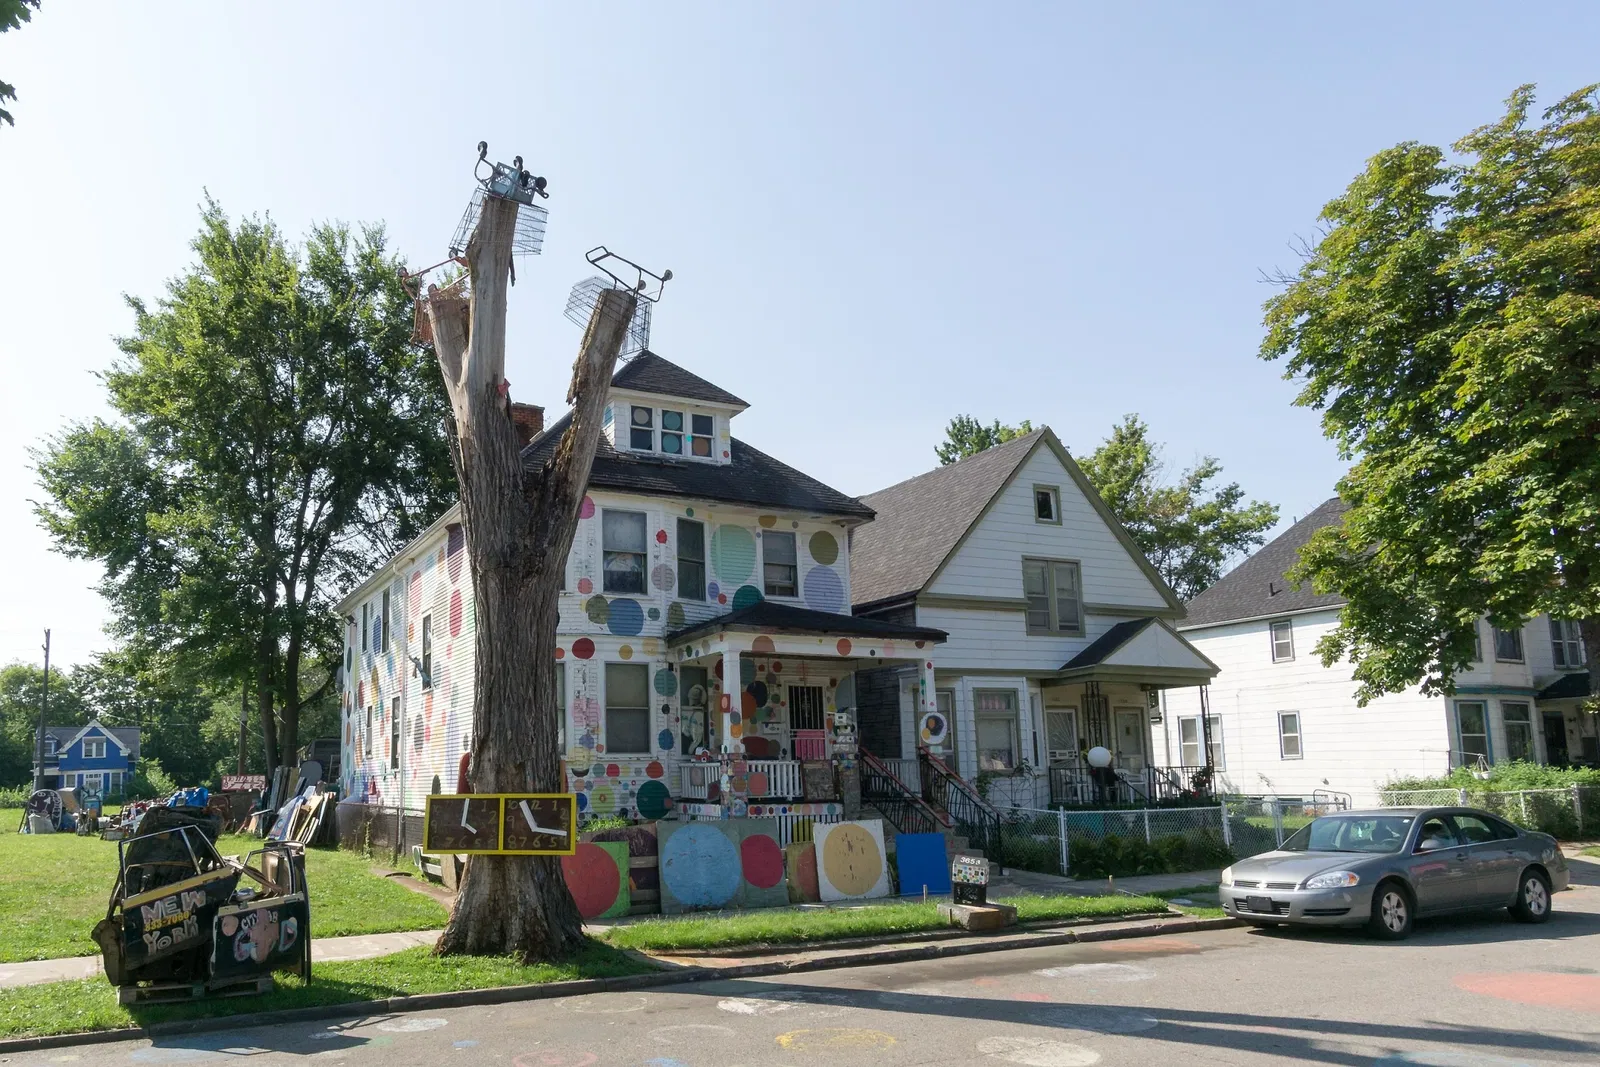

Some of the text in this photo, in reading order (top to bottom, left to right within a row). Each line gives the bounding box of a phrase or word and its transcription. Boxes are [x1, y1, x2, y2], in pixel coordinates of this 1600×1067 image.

[507, 799, 558, 811] 10 12 1
[506, 815, 515, 829] 9
[508, 835, 516, 849] 8
[519, 836, 528, 847] 7
[532, 834, 541, 848] 6
[141, 890, 206, 925] NEW
[142, 915, 199, 956] YORK
